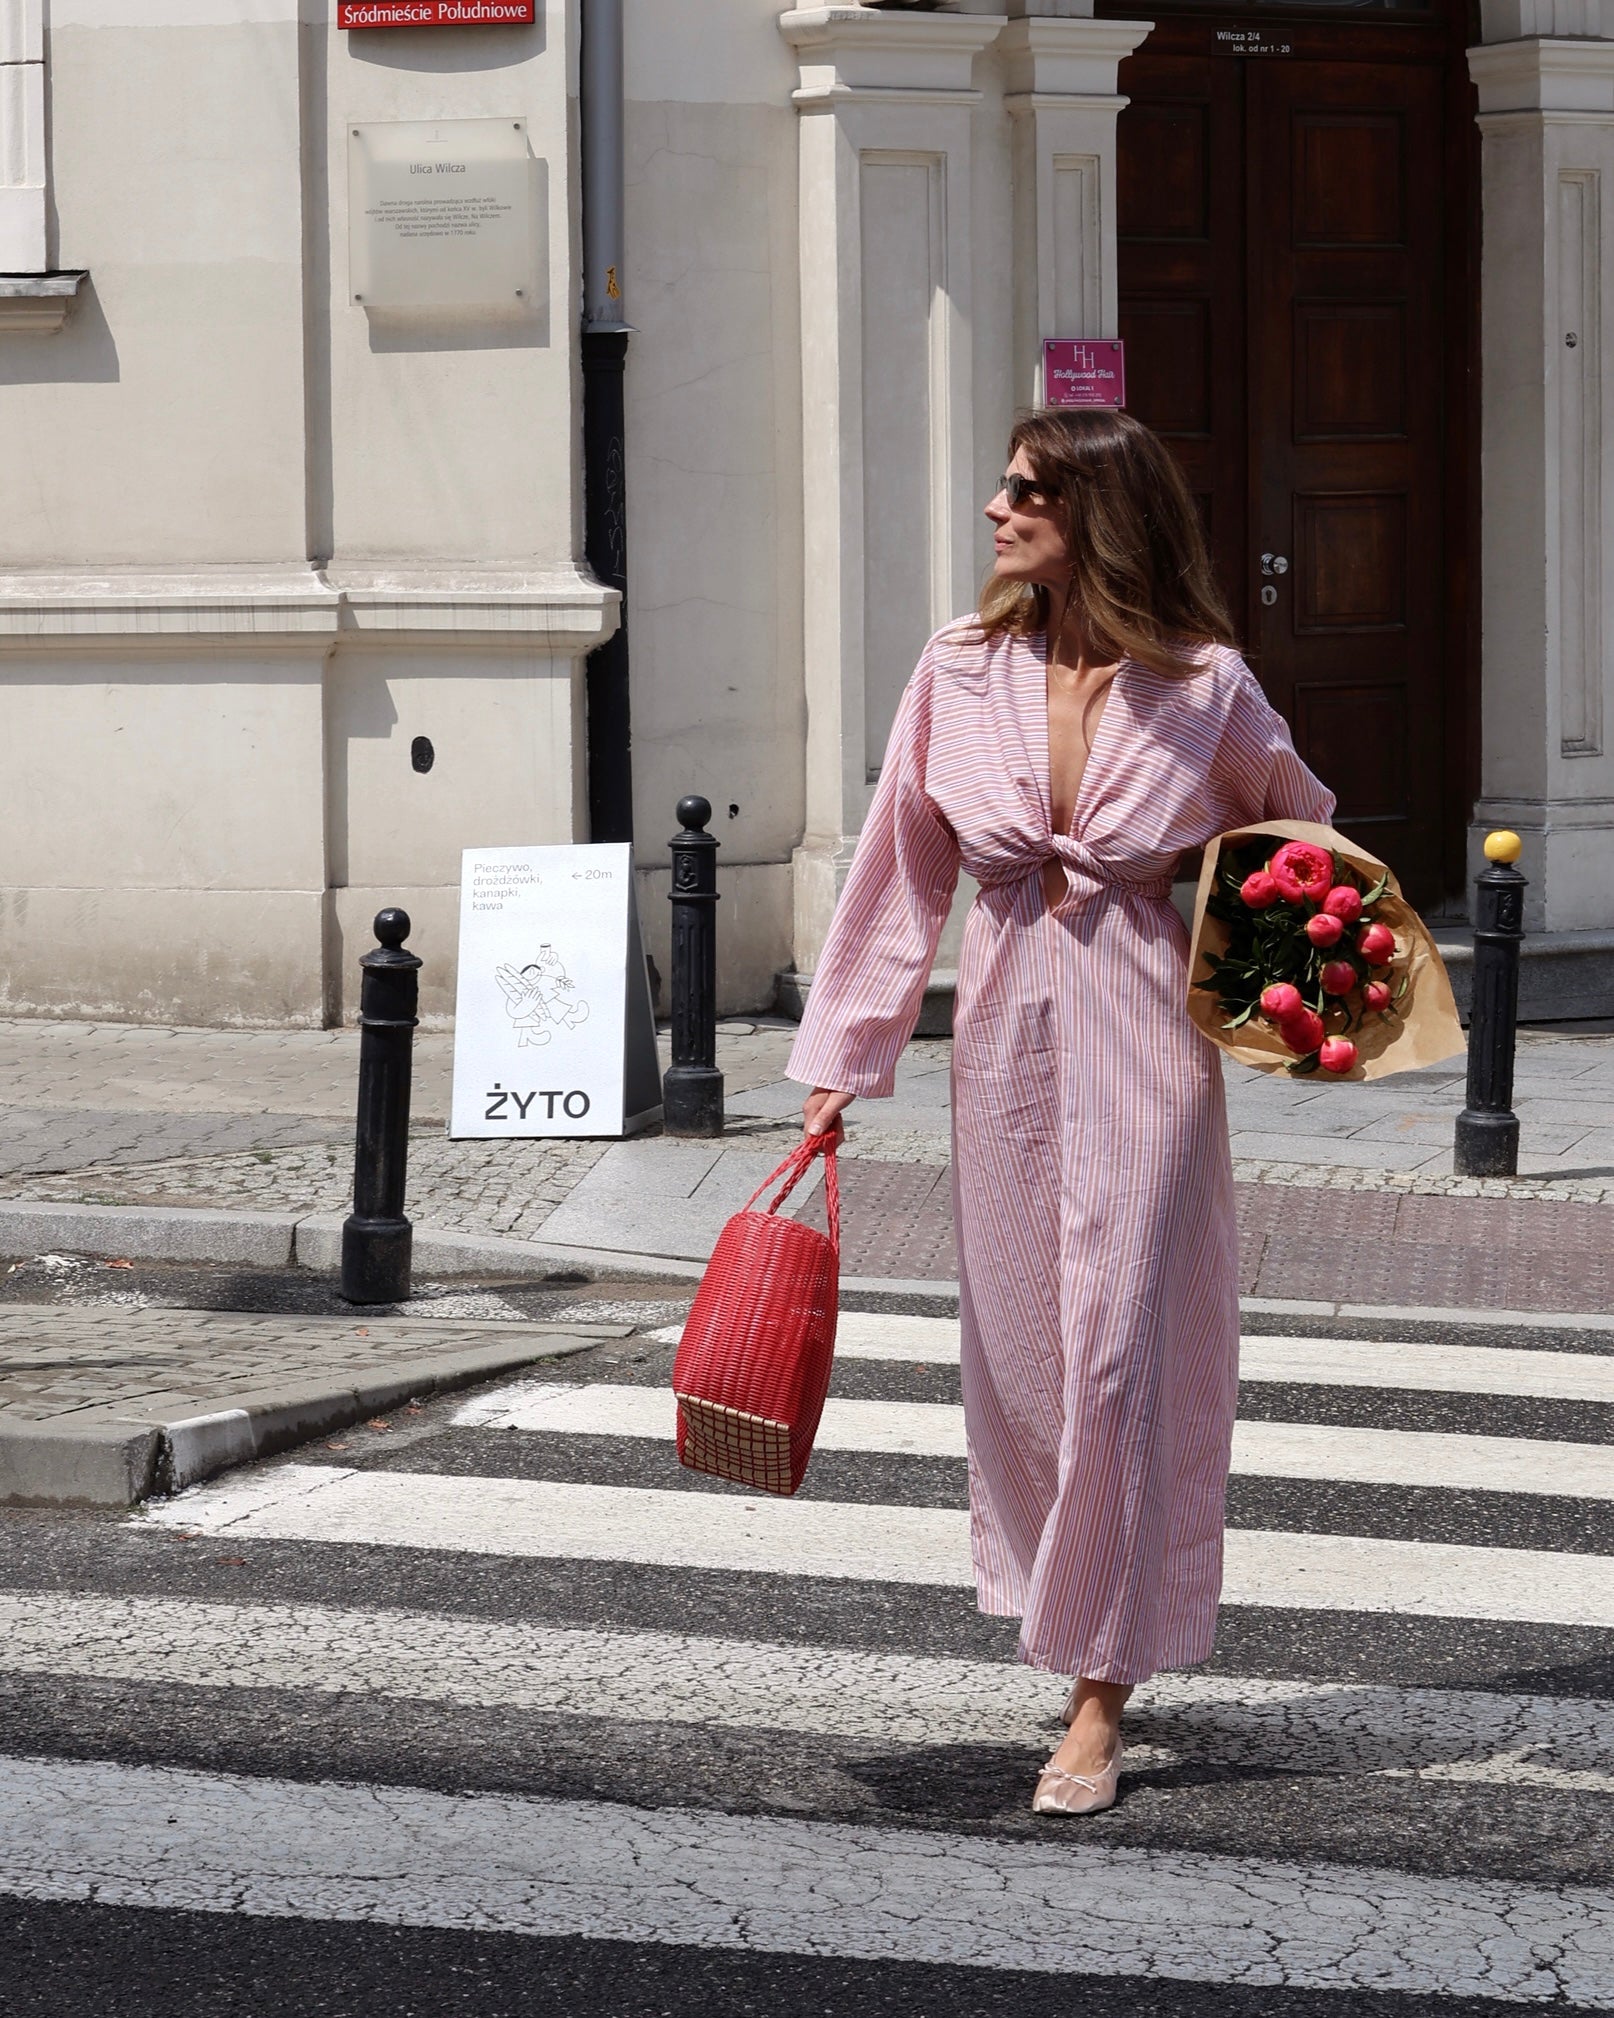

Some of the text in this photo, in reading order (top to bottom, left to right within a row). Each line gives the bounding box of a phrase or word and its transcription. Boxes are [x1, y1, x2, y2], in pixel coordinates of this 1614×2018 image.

[344, 1, 528, 24] Śródmieście Południowe
[1216, 32, 1260, 41] Wilcza 2/4
[1233, 44, 1246, 52] lok.
[410, 163, 466, 174] Ulica Wilcza
[1053, 369, 1115, 382] Hollywood Hair
[474, 863, 533, 874] Pieczywo,
[473, 873, 543, 886] drożdżówki,
[585, 869, 613, 880] 20m
[473, 887, 521, 899] kanapki,
[472, 901, 503, 910] kawa
[485, 1083, 590, 1120] ŻYTO
